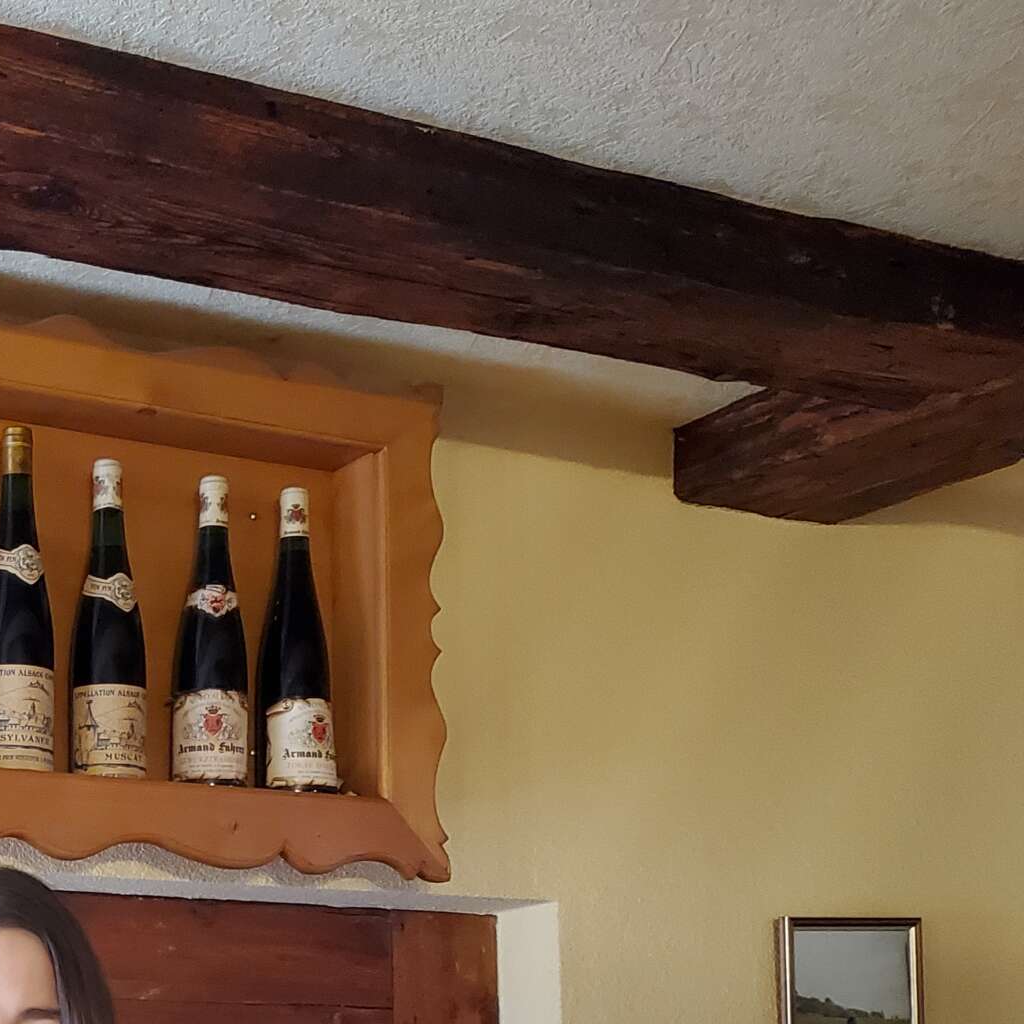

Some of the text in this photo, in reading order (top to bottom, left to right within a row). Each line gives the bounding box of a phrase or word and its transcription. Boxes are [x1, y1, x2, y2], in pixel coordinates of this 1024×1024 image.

[0, 734, 50, 746] SYLVANE
[178, 742, 215, 755] Armand
[282, 748, 323, 760] Armand
[104, 753, 142, 762] MUSCAT
